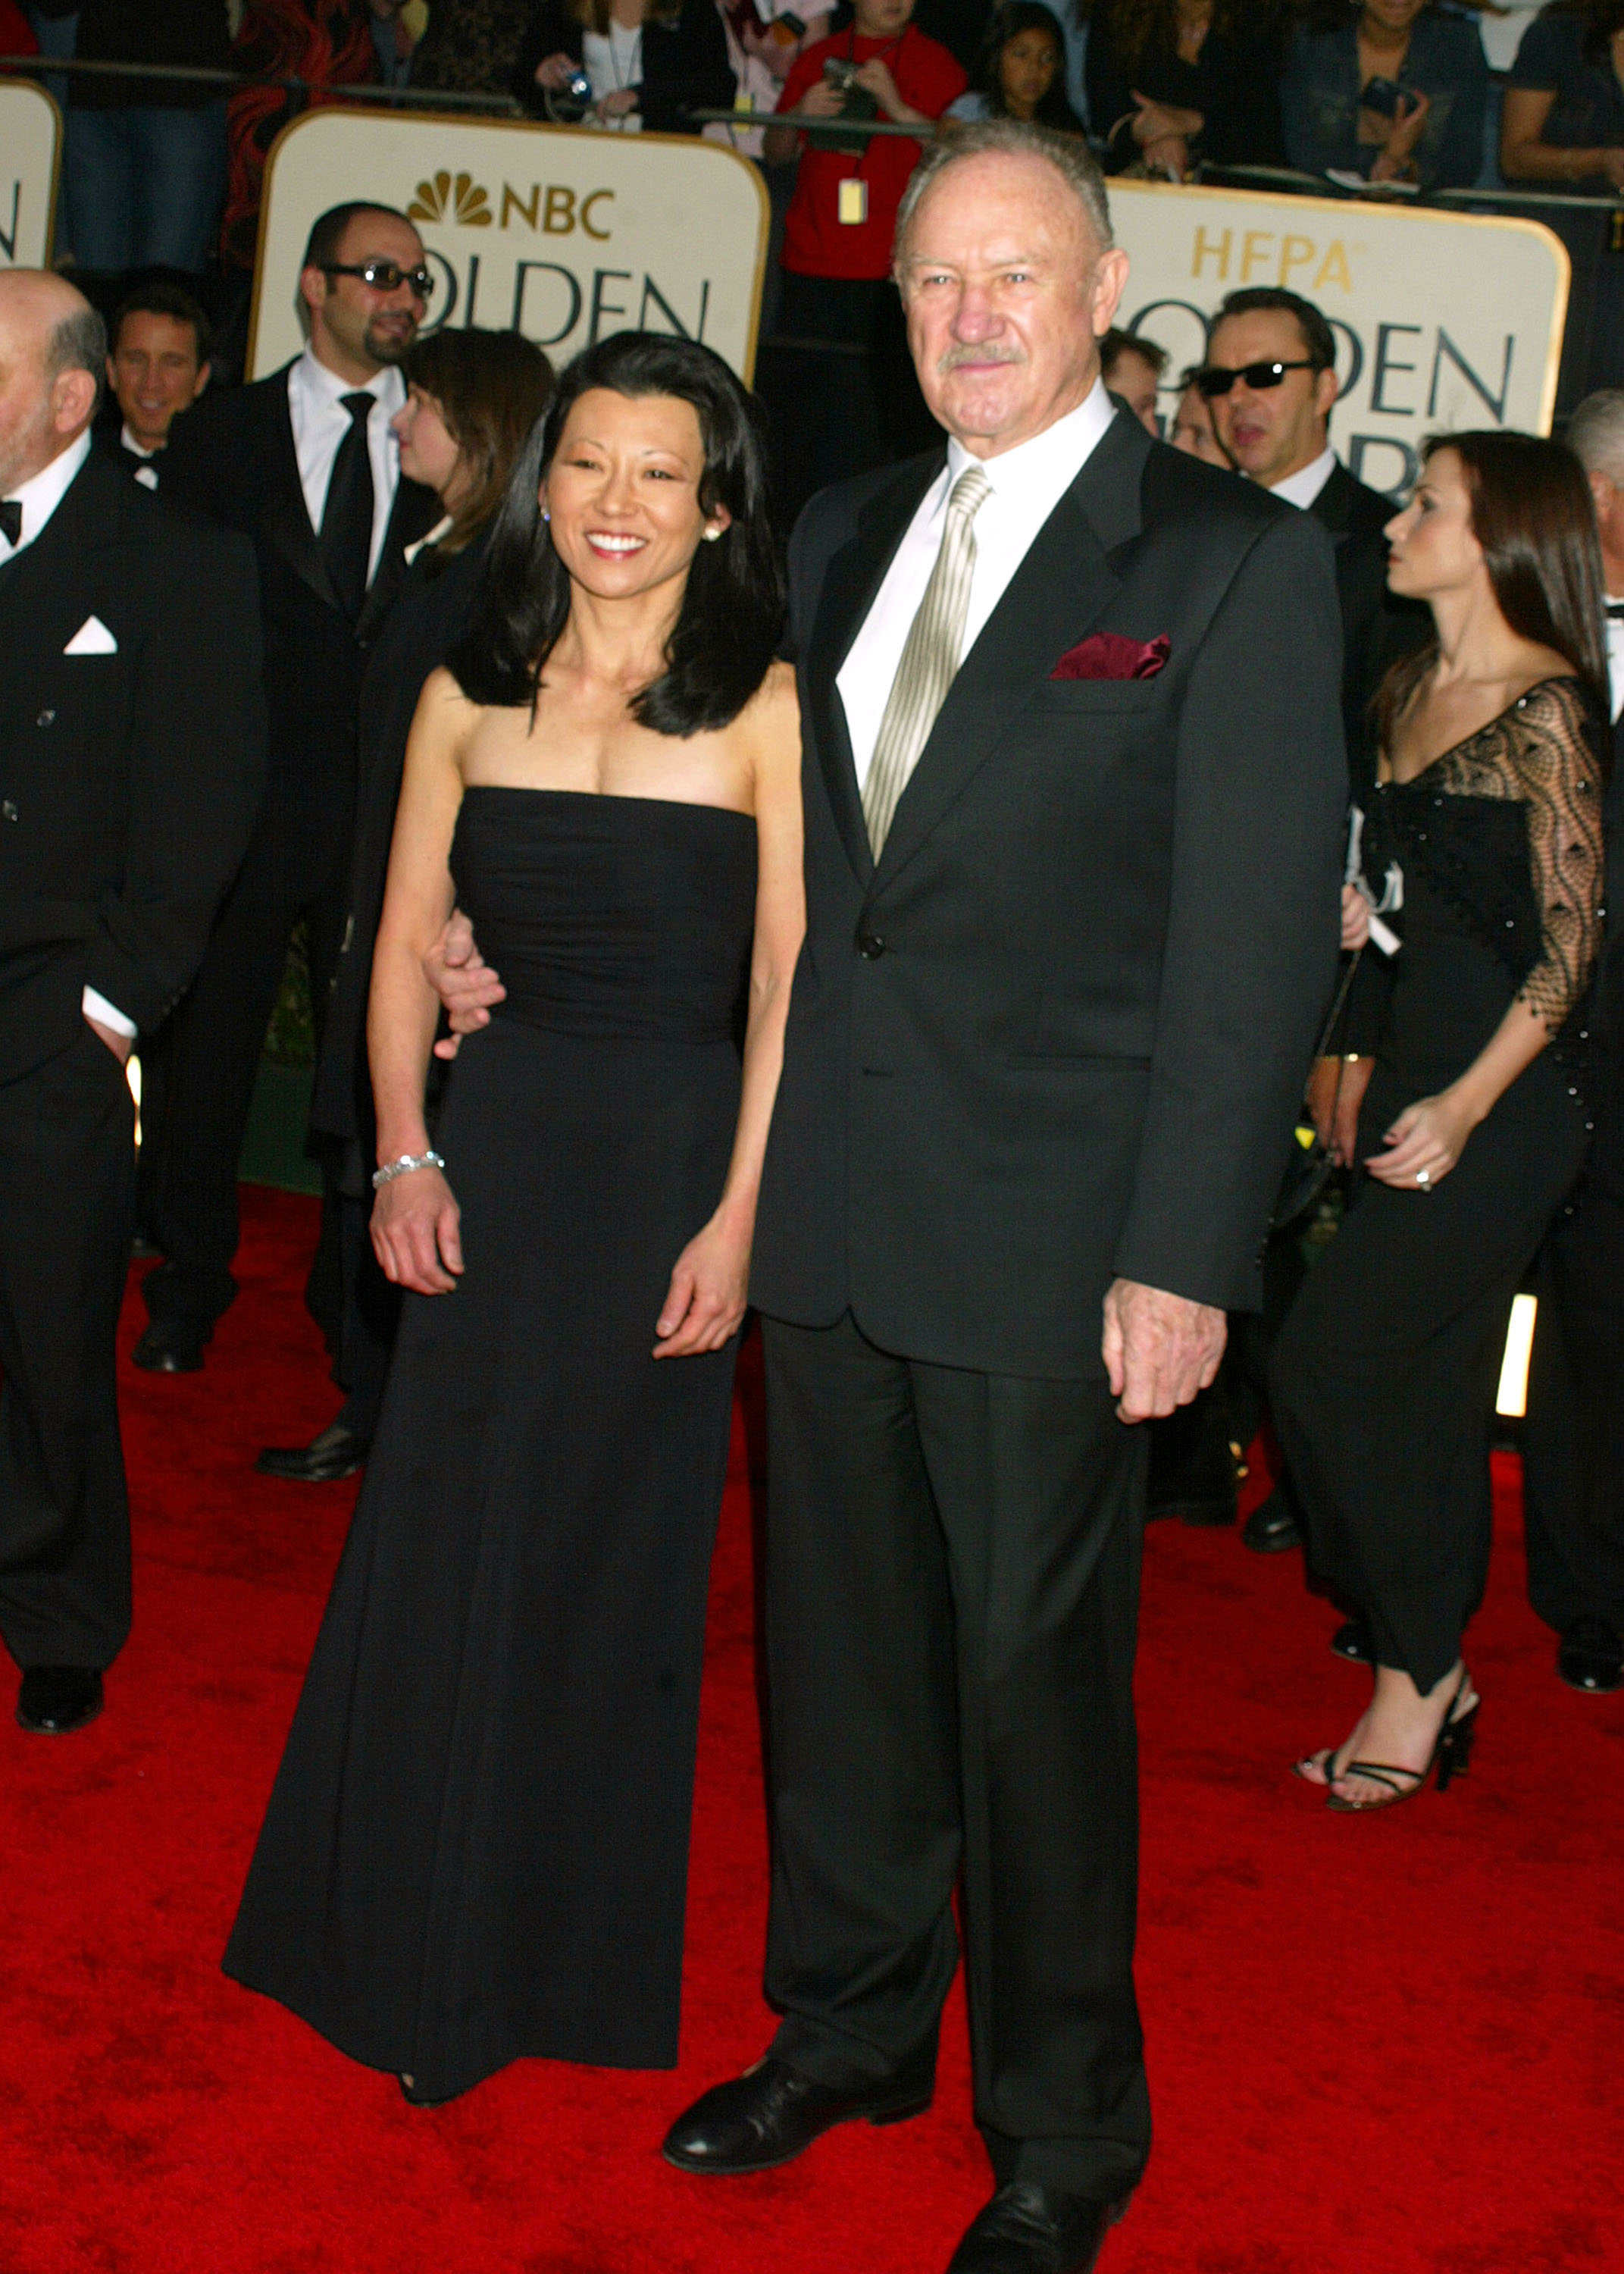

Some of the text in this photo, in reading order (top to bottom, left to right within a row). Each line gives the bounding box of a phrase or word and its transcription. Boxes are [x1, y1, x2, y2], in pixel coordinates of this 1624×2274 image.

[499, 181, 615, 240] NBC
[1190, 225, 1353, 295] HFPA
[421, 248, 709, 346] OLDEN
